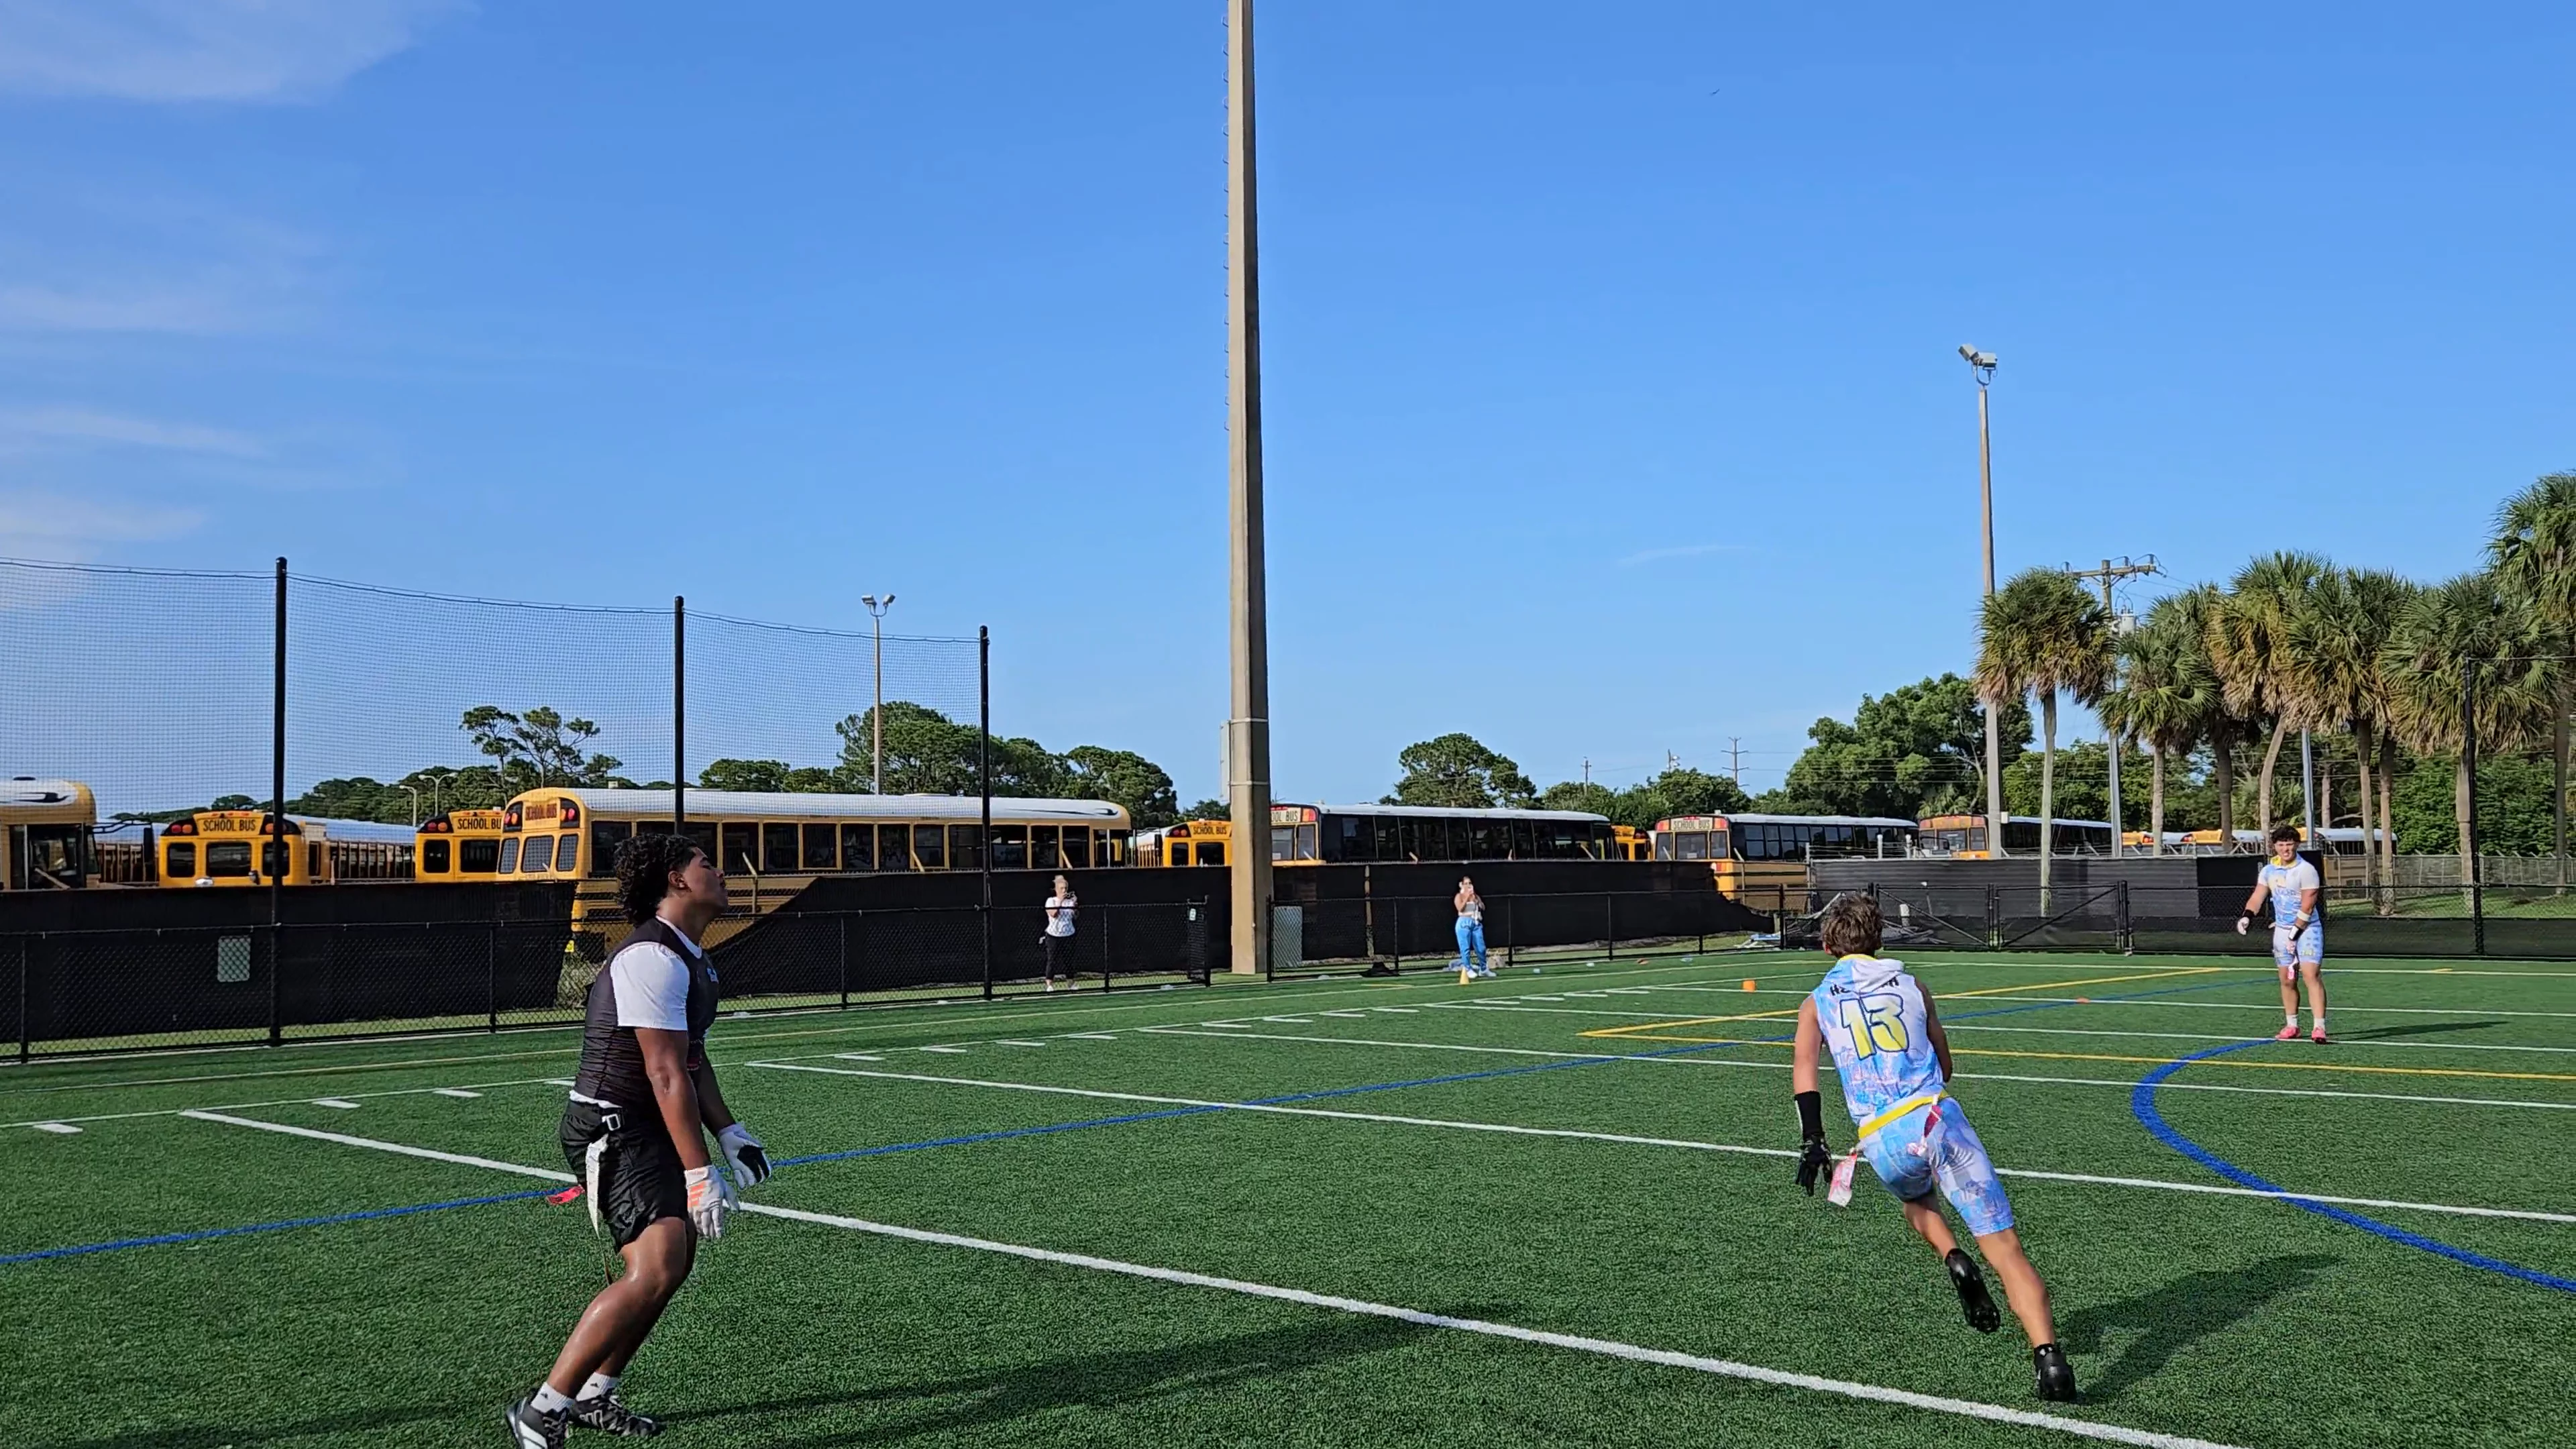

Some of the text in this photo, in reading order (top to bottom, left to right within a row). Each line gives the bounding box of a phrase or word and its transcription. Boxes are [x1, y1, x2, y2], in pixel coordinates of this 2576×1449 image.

[525, 805, 545, 820] SCHOOL
[1285, 810, 1297, 822] BUS
[203, 819, 256, 832] SCHOOL BUS
[458, 818, 502, 830] SCHOOL BU
[1674, 819, 1710, 830] SCHOOL BUS
[1193, 826, 1227, 835] SCHOOL BUS
[1839, 993, 1909, 1061] 13
